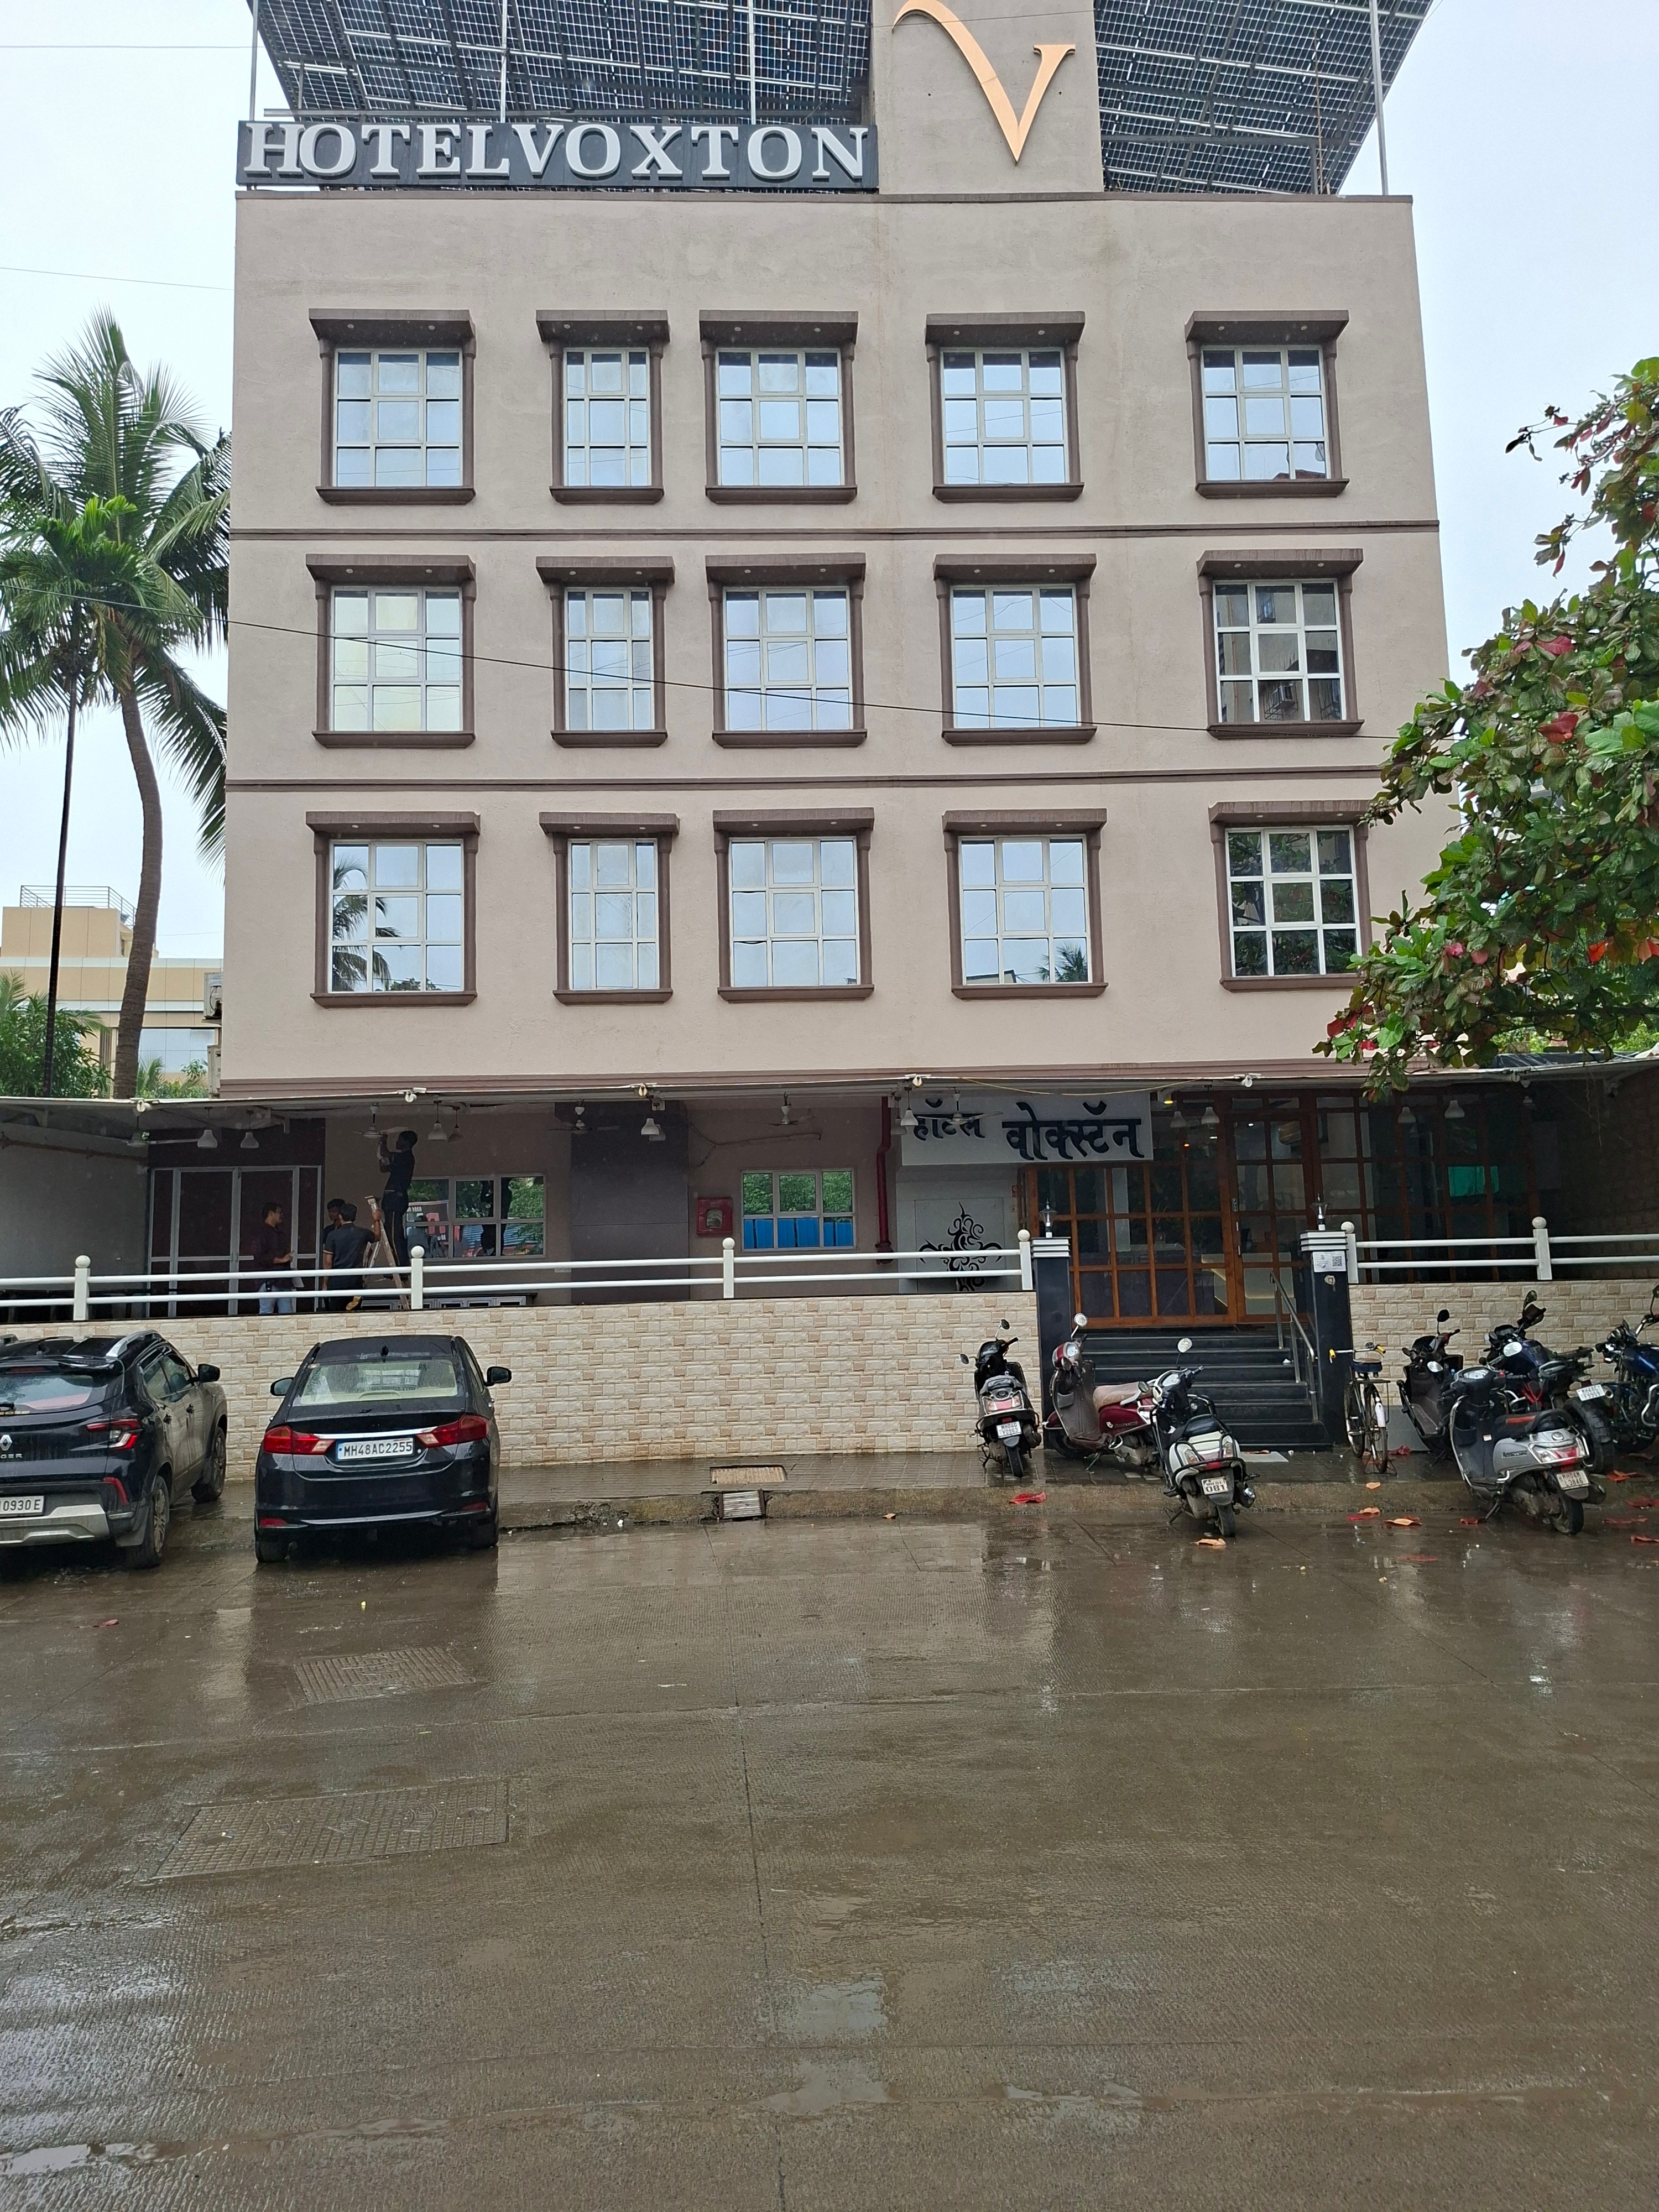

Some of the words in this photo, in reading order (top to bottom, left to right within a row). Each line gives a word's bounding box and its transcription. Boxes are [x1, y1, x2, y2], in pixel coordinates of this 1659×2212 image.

[243, 123, 510, 177] HOTEL
[510, 123, 869, 179] VOXTON
[343, 1441, 413, 1457] MH48AC2255
